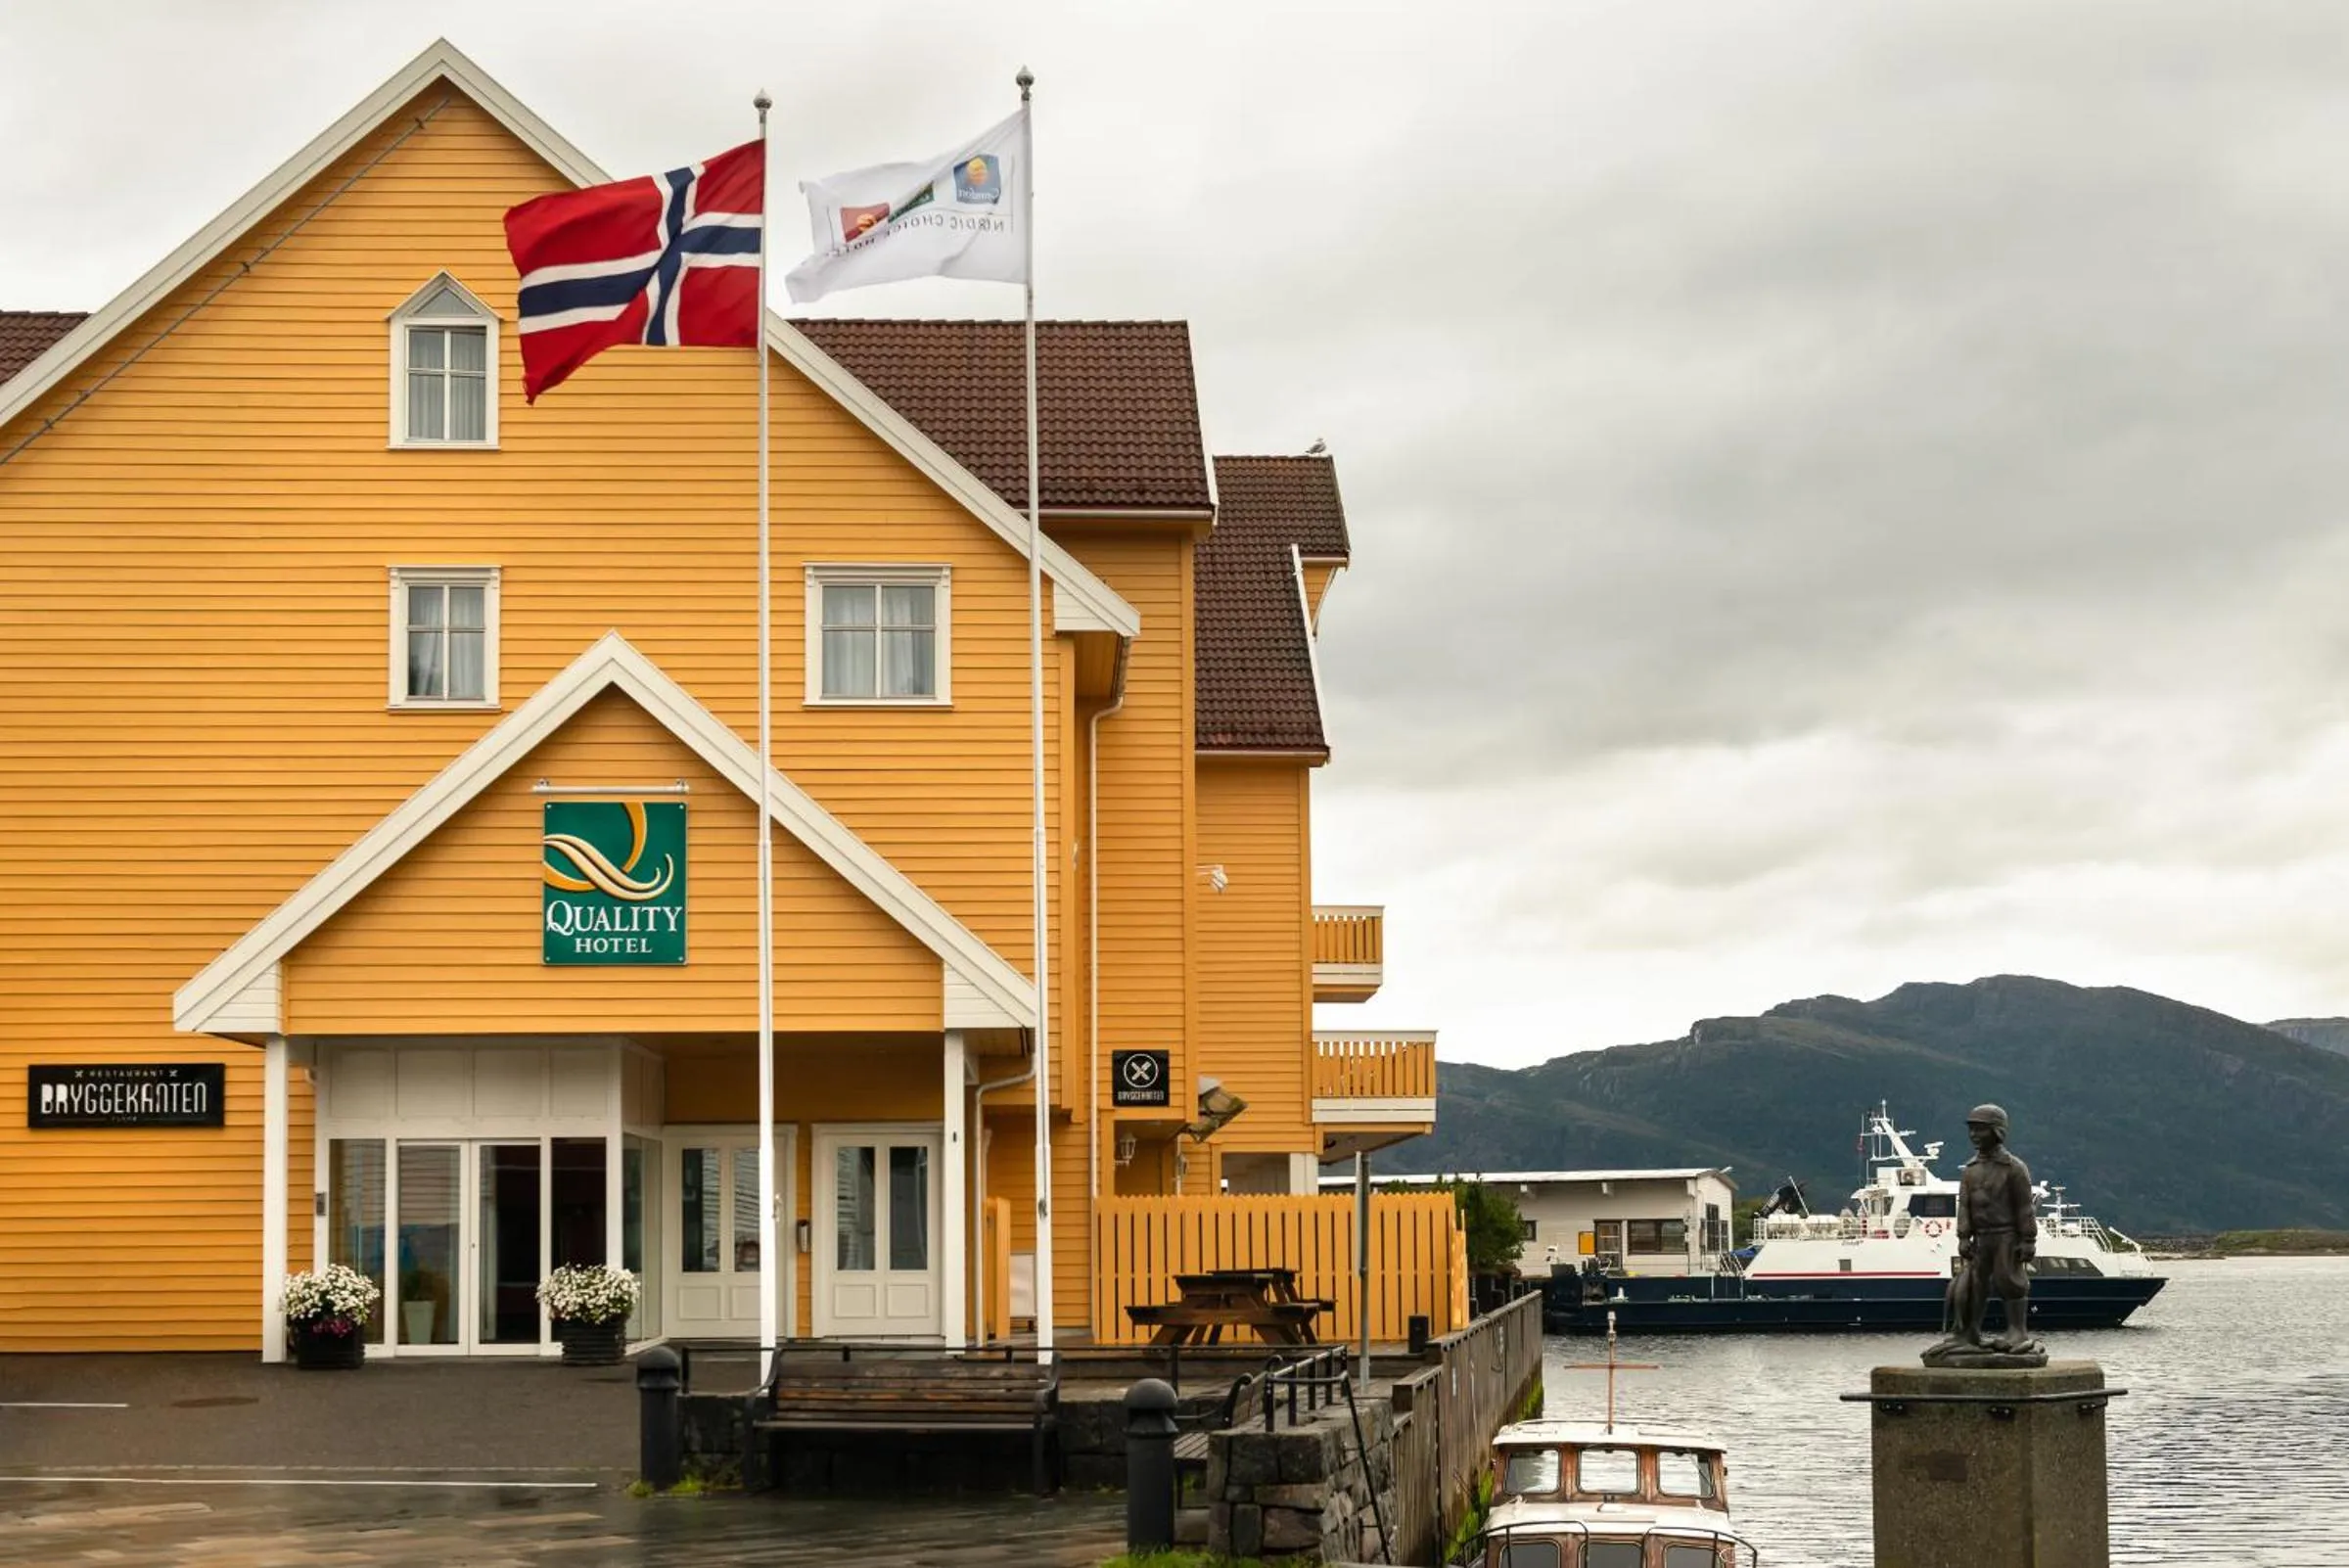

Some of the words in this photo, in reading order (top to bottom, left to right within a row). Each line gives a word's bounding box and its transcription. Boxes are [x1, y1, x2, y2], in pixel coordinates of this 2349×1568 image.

[546, 899, 683, 936] QUALITY
[575, 938, 652, 953] HOTEL
[40, 1082, 207, 1114] BRYGGEKANTEN
